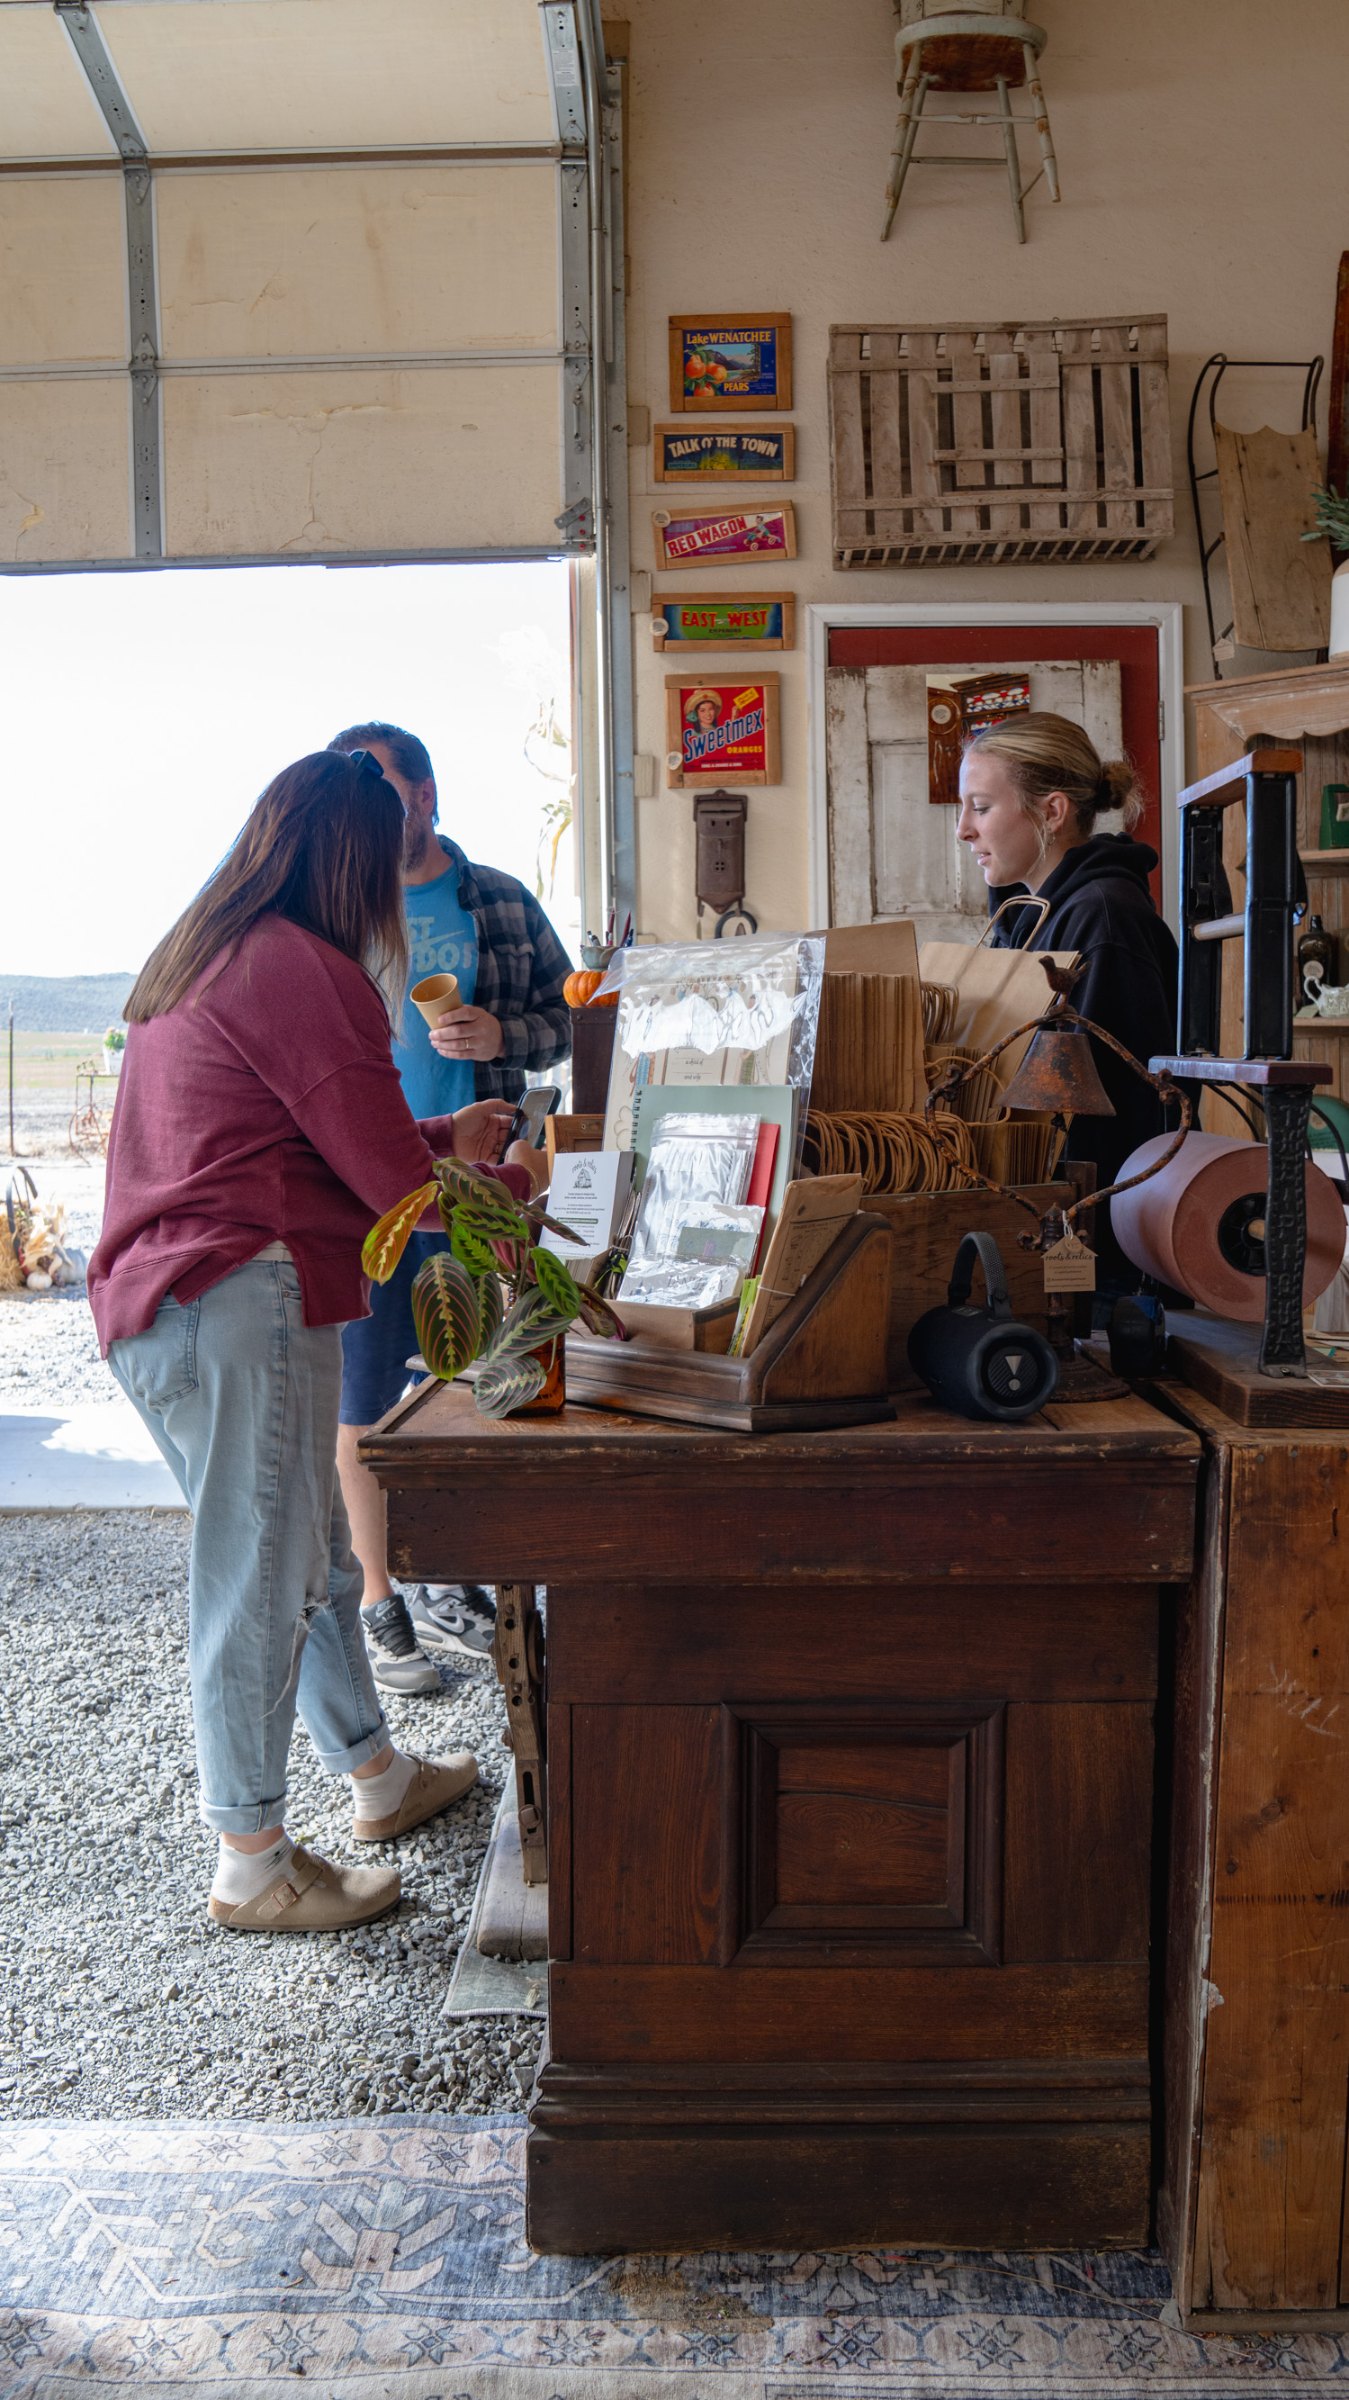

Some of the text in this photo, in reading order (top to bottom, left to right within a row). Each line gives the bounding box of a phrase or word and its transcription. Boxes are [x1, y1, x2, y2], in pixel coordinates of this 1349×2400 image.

[686, 331, 772, 345] Lake WENATCHEE
[723, 382, 750, 392] PEARS
[667, 437, 701, 458] TALK
[716, 436, 737, 448] THE
[741, 437, 779, 458] TOWN
[667, 534, 698, 557] RED
[697, 516, 747, 545] WAGON
[681, 609, 769, 628] EAST WEST
[684, 708, 764, 763] Sweetmex
[726, 745, 763, 754] ORANGES
